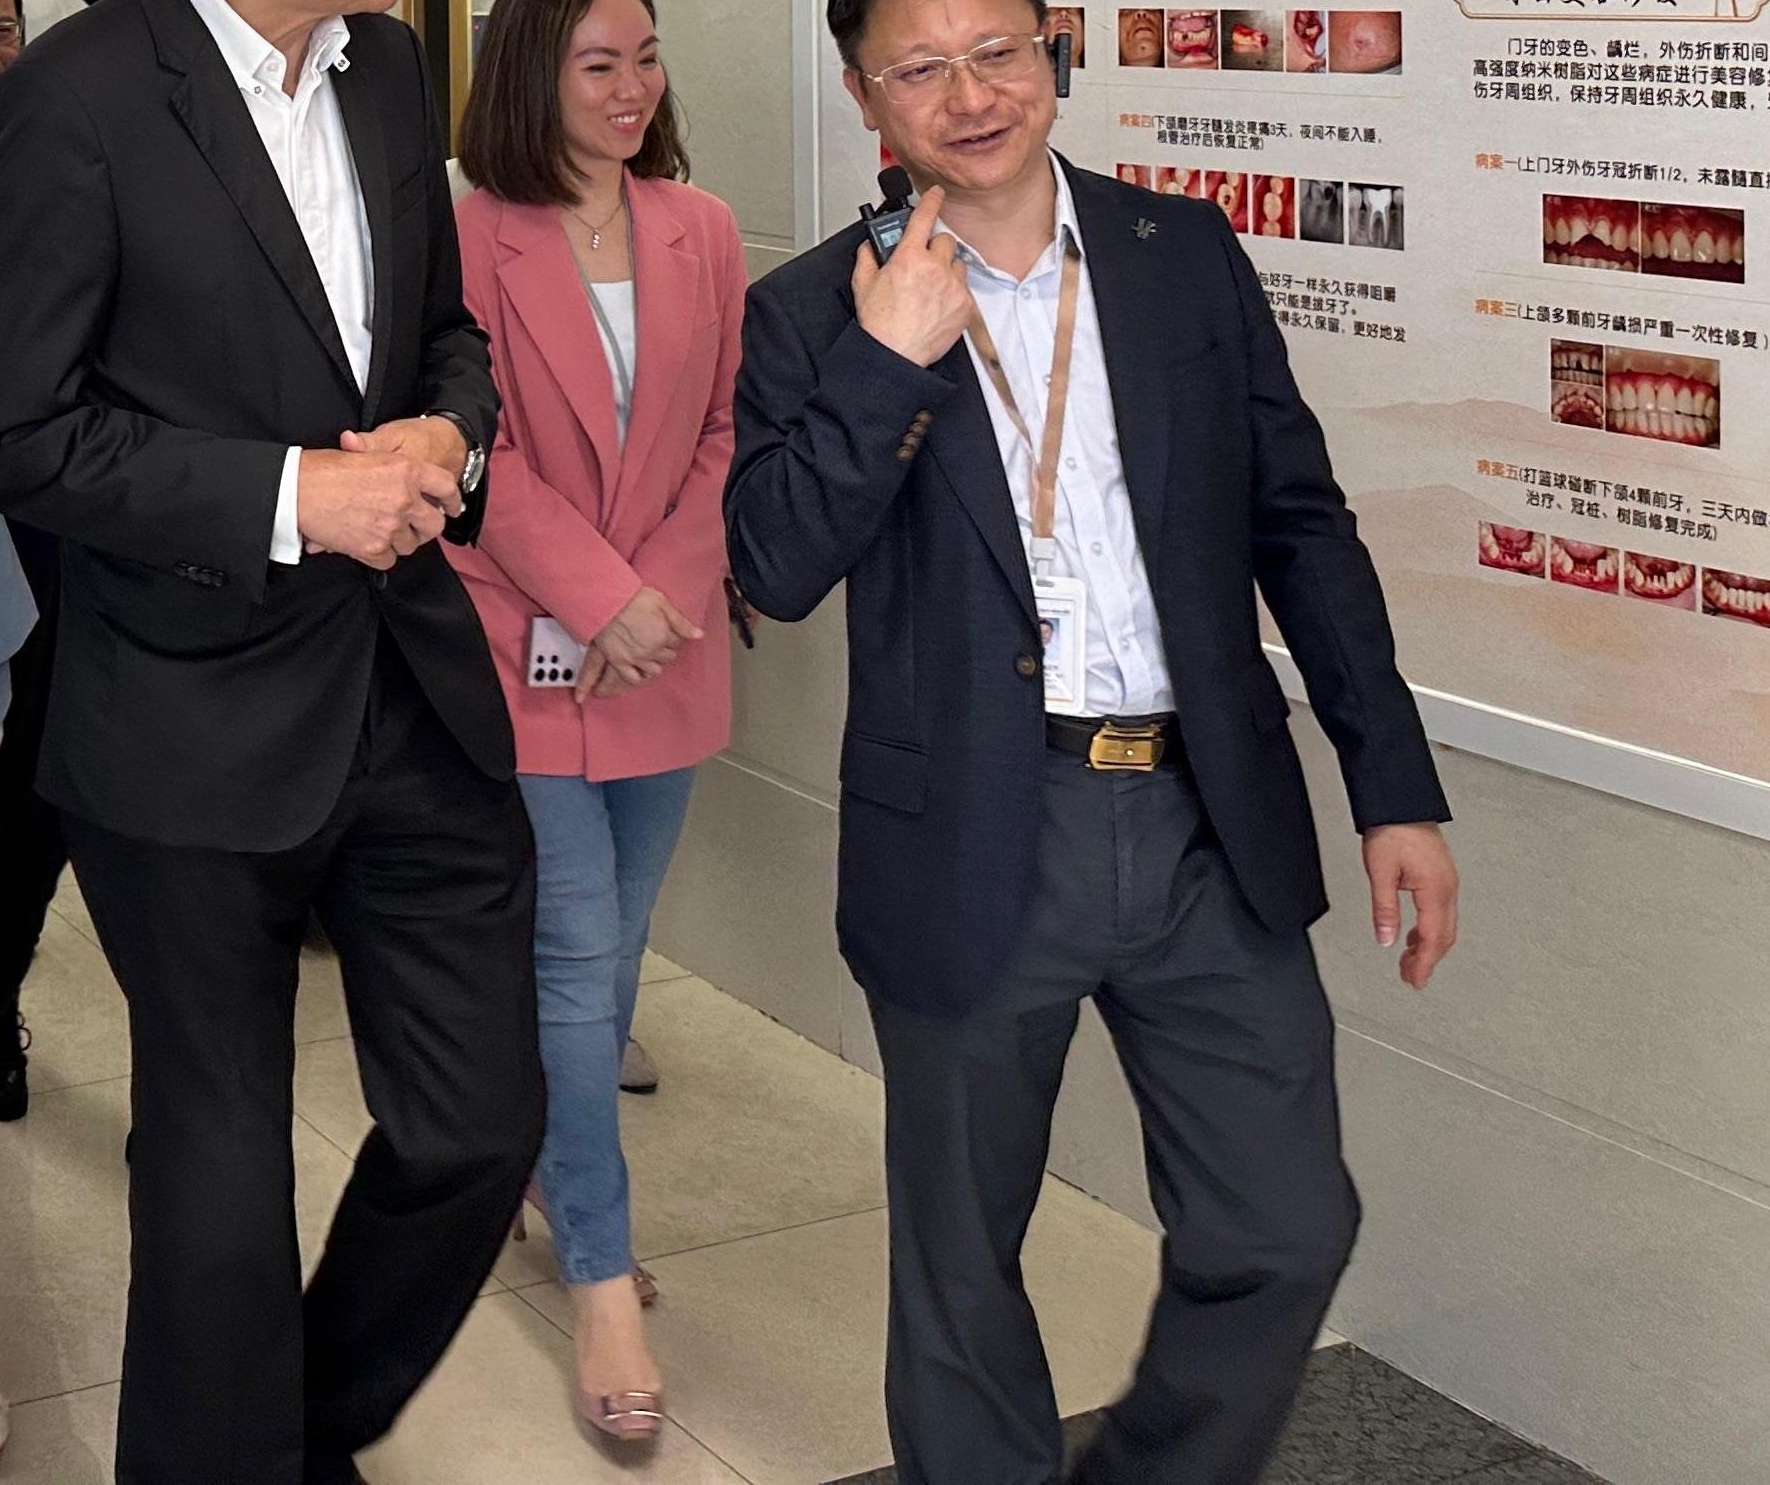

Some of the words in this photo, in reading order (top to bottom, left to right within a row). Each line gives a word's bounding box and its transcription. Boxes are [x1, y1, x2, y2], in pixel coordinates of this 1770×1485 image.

[1472, 59, 1770, 88] 高强度纳米树脂对这些病症进行美容修
[1473, 82, 1770, 112] 伤牙周组织，保持牙周组织永久健康，
